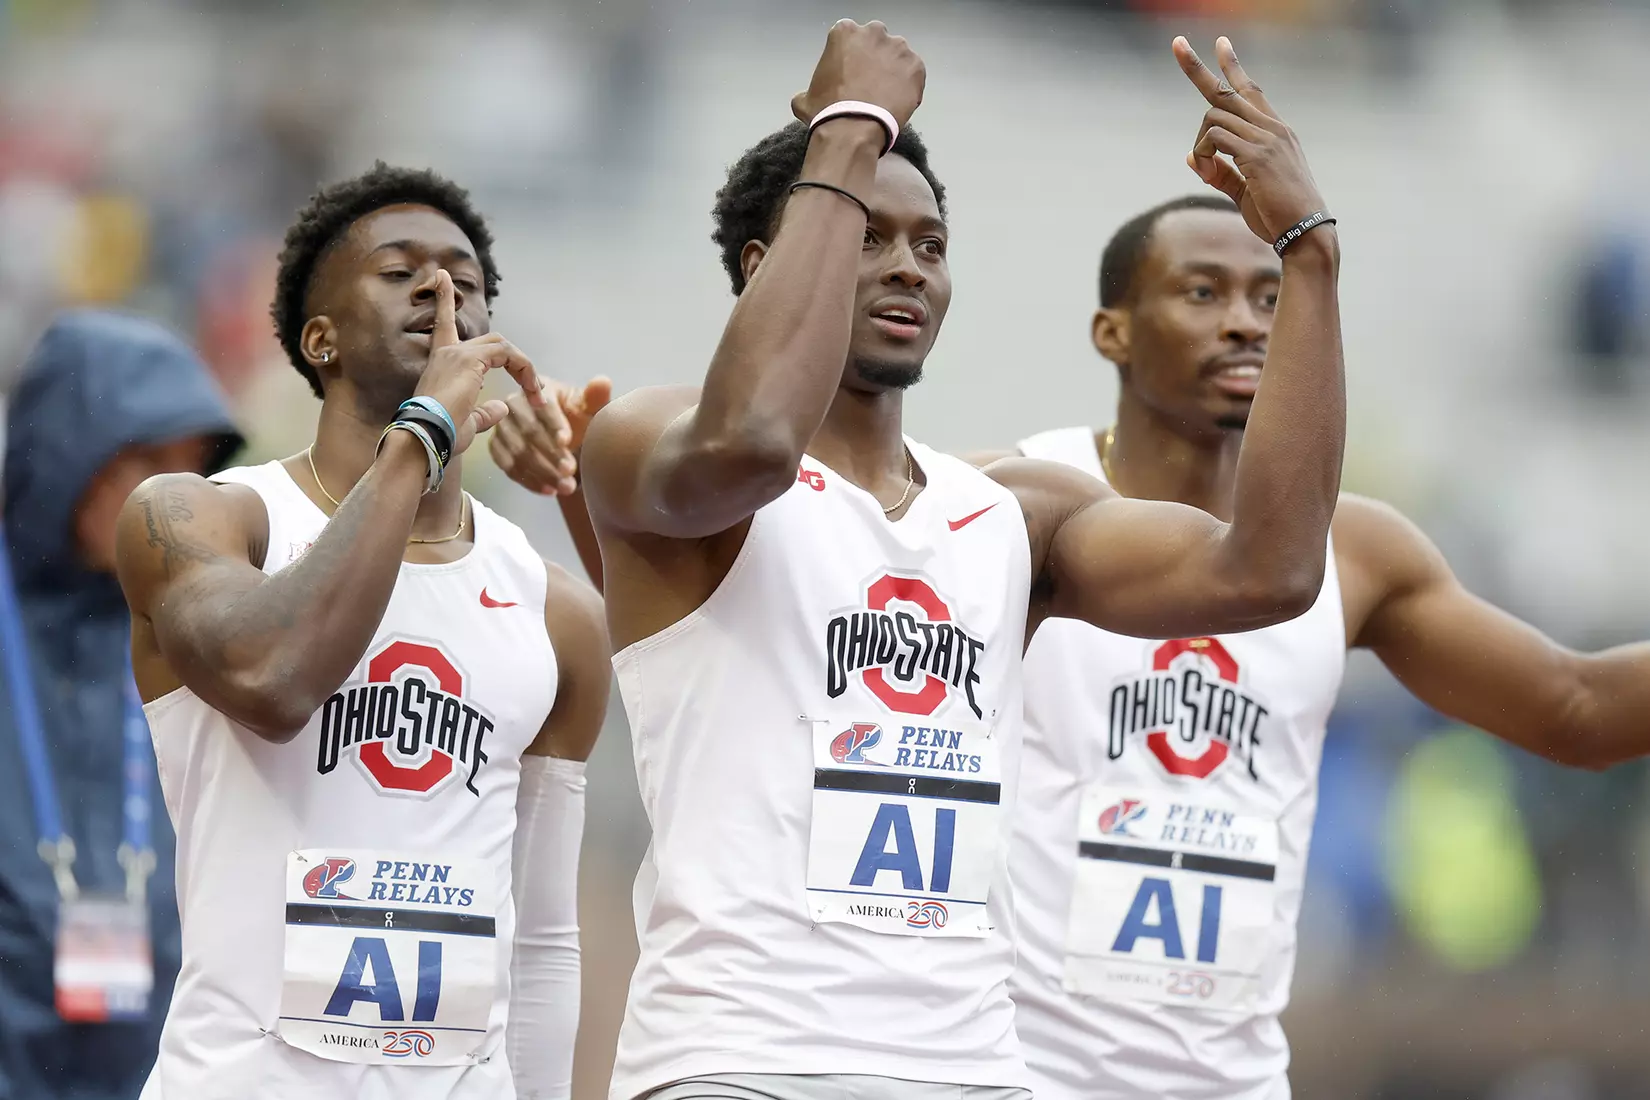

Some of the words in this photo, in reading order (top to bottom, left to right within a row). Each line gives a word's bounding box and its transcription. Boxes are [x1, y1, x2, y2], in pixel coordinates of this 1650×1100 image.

[1286, 227, 1302, 240] Big
[1298, 218, 1315, 230] Ten
[827, 612, 898, 699] OHIO
[893, 610, 985, 721] STATE
[316, 684, 399, 776] OHIO
[396, 677, 495, 798] STATE
[898, 725, 964, 750] PENN
[1108, 677, 1176, 761] OHIO
[1179, 669, 1269, 782] STATE
[893, 747, 982, 774] RELAYS
[1166, 803, 1236, 828] PENN
[848, 802, 957, 894] AI
[1160, 824, 1258, 852] RELAYS
[372, 860, 453, 884] PENN
[367, 881, 475, 908] RELAYS
[846, 904, 905, 920] AMERICA
[906, 900, 950, 930] 250
[1110, 876, 1223, 964] AI
[322, 936, 443, 1022] AI
[319, 1033, 380, 1050] AMERICA
[381, 1029, 436, 1058] 250
